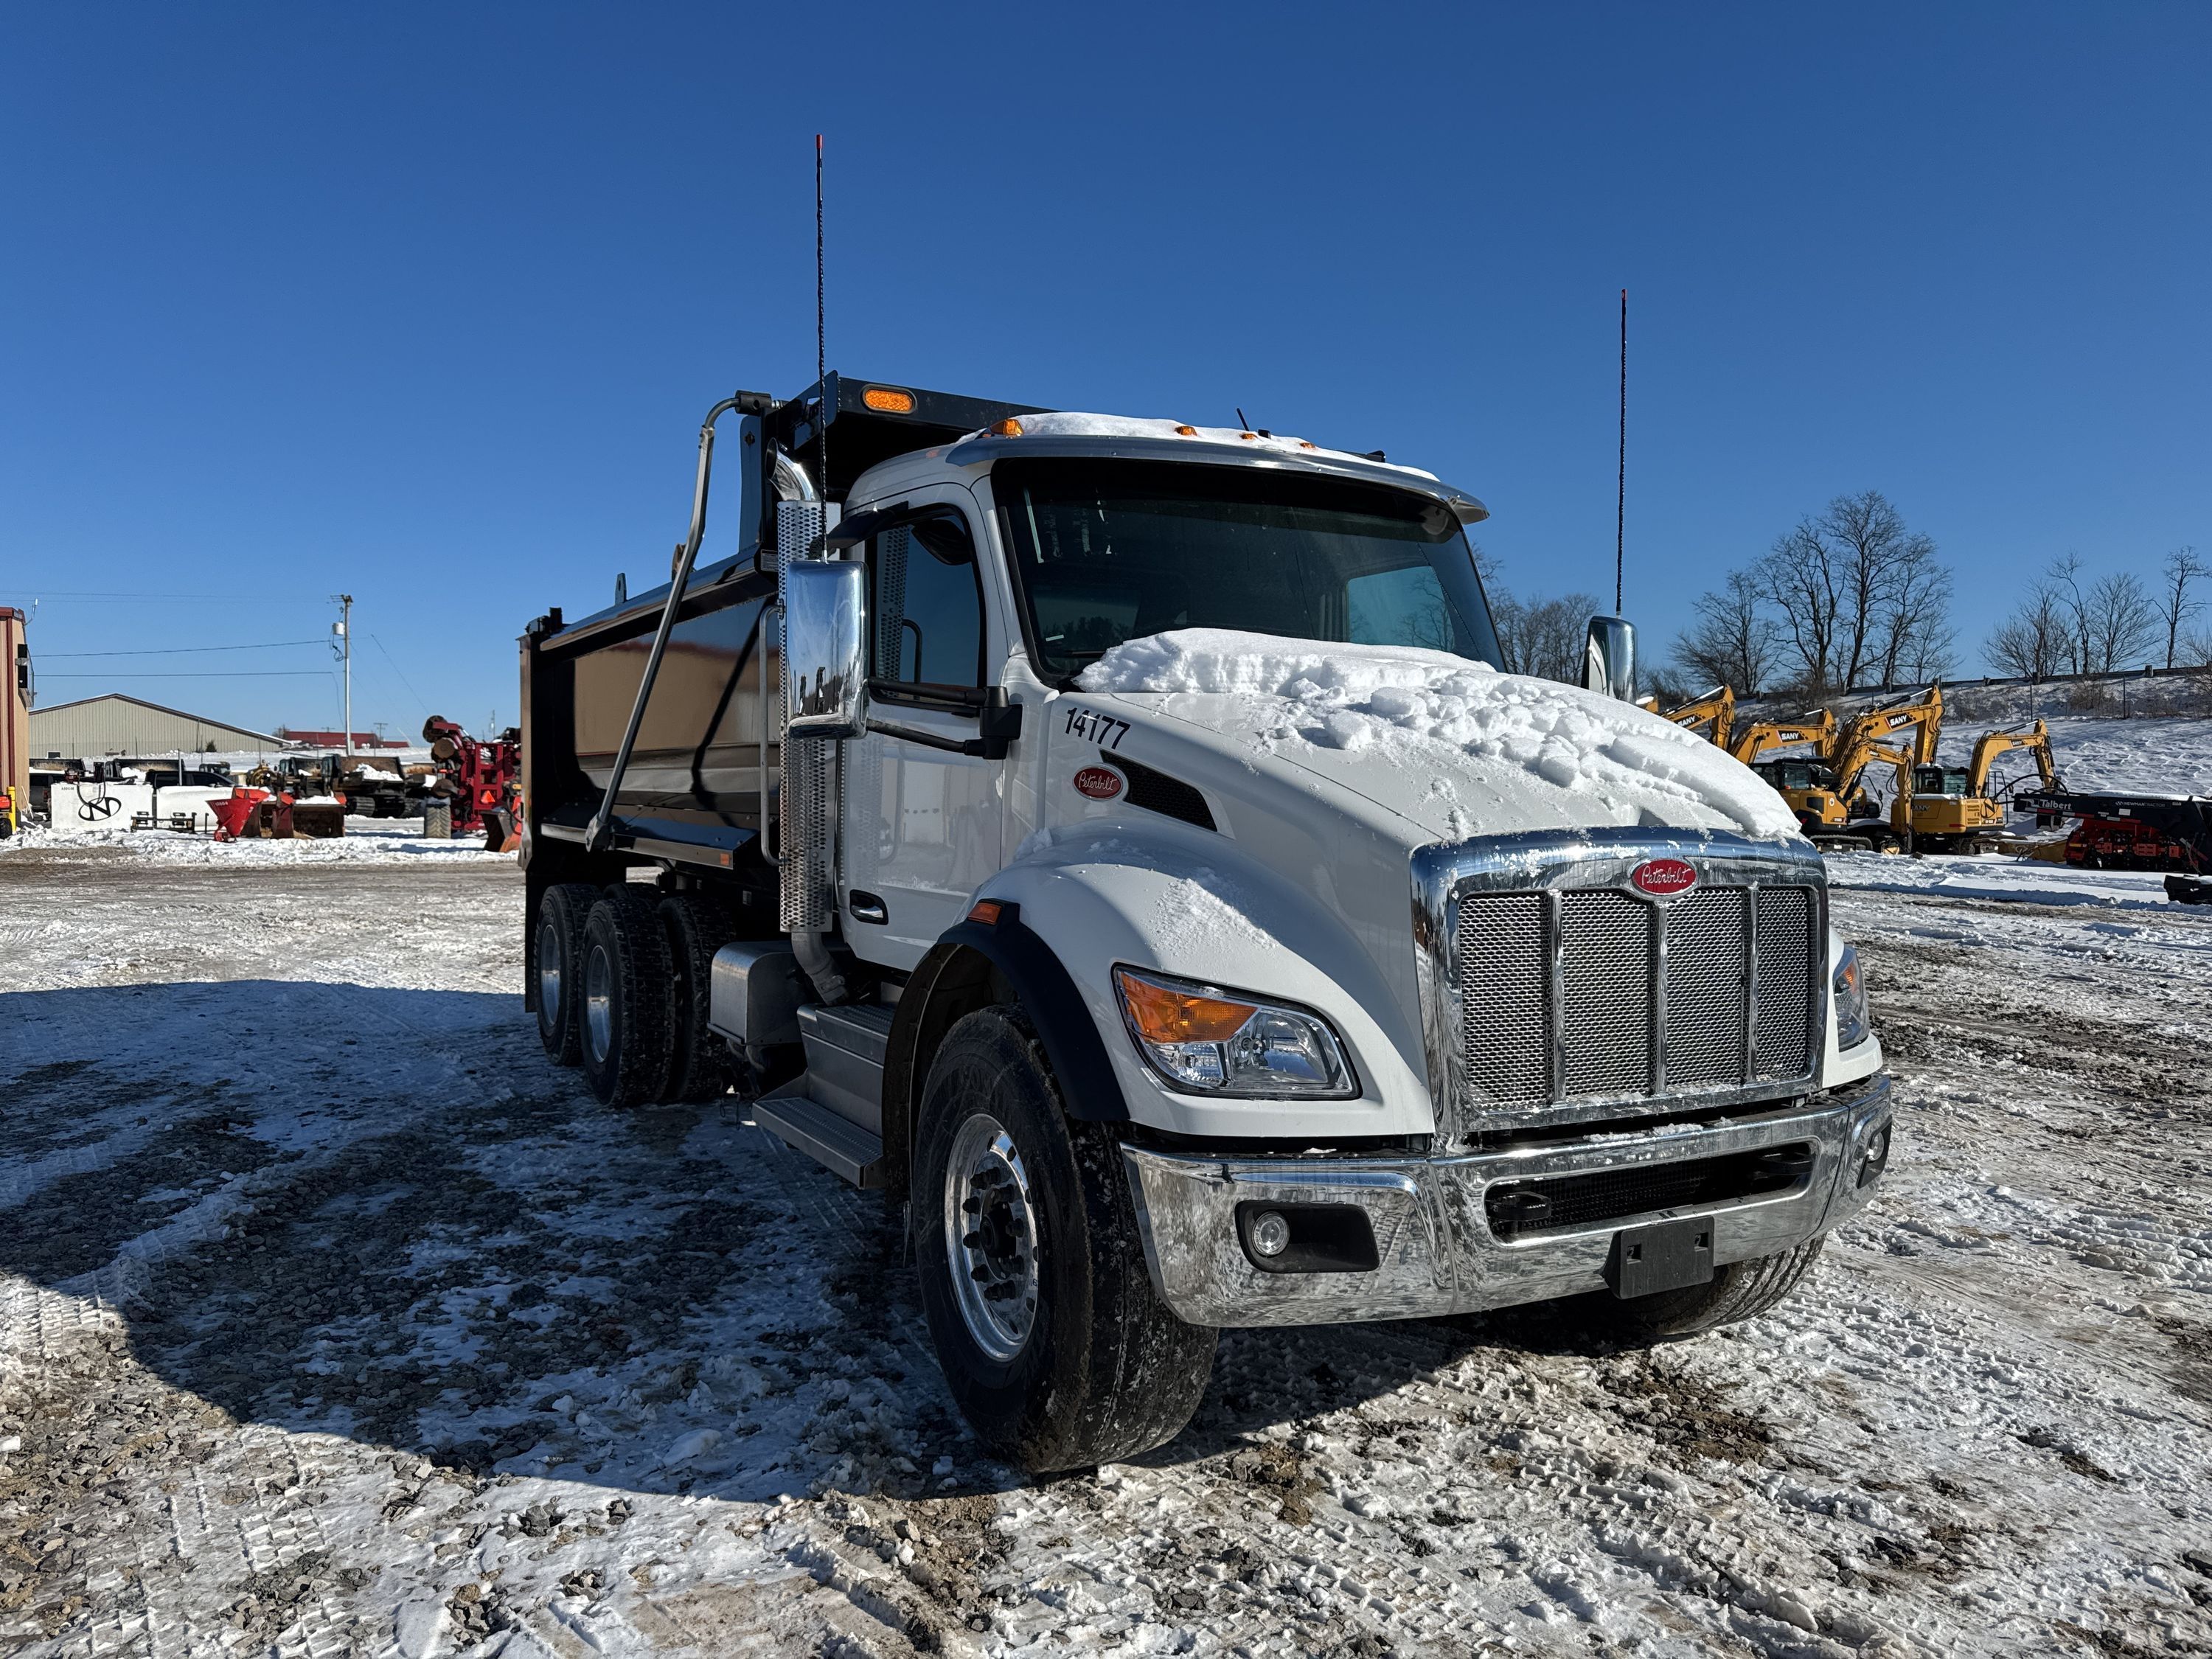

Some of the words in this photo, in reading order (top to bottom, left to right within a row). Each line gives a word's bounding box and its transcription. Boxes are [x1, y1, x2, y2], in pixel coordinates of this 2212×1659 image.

[1677, 715, 1695, 726] SANY
[1890, 714, 1907, 726] SANY
[1065, 707, 1131, 750] 14177
[1781, 732, 1799, 740] SANY
[1078, 771, 1118, 791] Peterbilt
[2040, 799, 2072, 810] Talbert
[1641, 865, 1692, 886] Peterbilt
